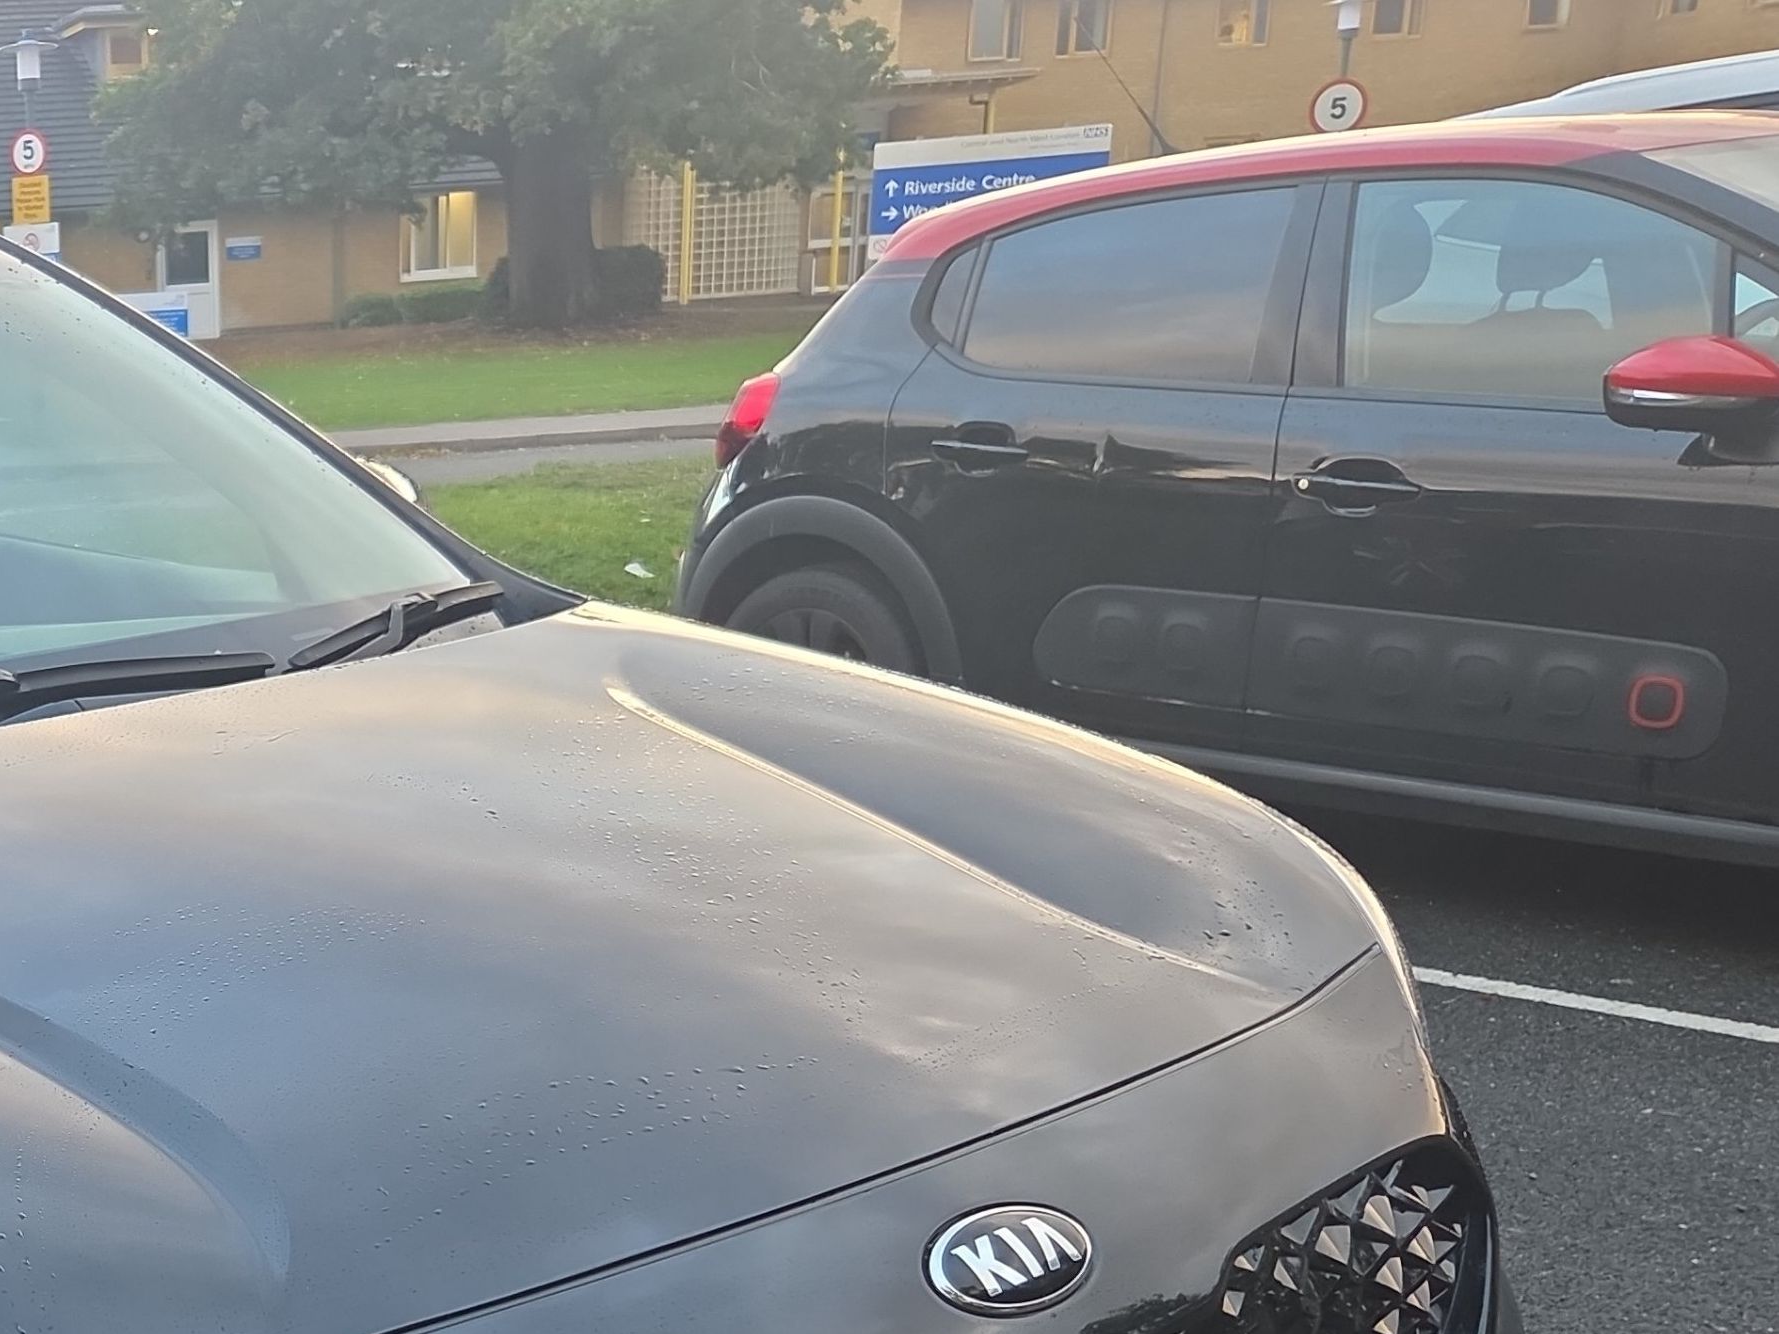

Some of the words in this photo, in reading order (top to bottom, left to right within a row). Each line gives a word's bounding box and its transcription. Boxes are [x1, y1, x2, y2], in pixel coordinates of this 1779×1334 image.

[1330, 96, 1347, 119] 5
[1084, 126, 1109, 138] NHS
[23, 140, 34, 160] 5
[904, 175, 976, 196] Riverside
[981, 172, 1036, 190] Centre
[950, 1216, 1082, 1297] KIA
